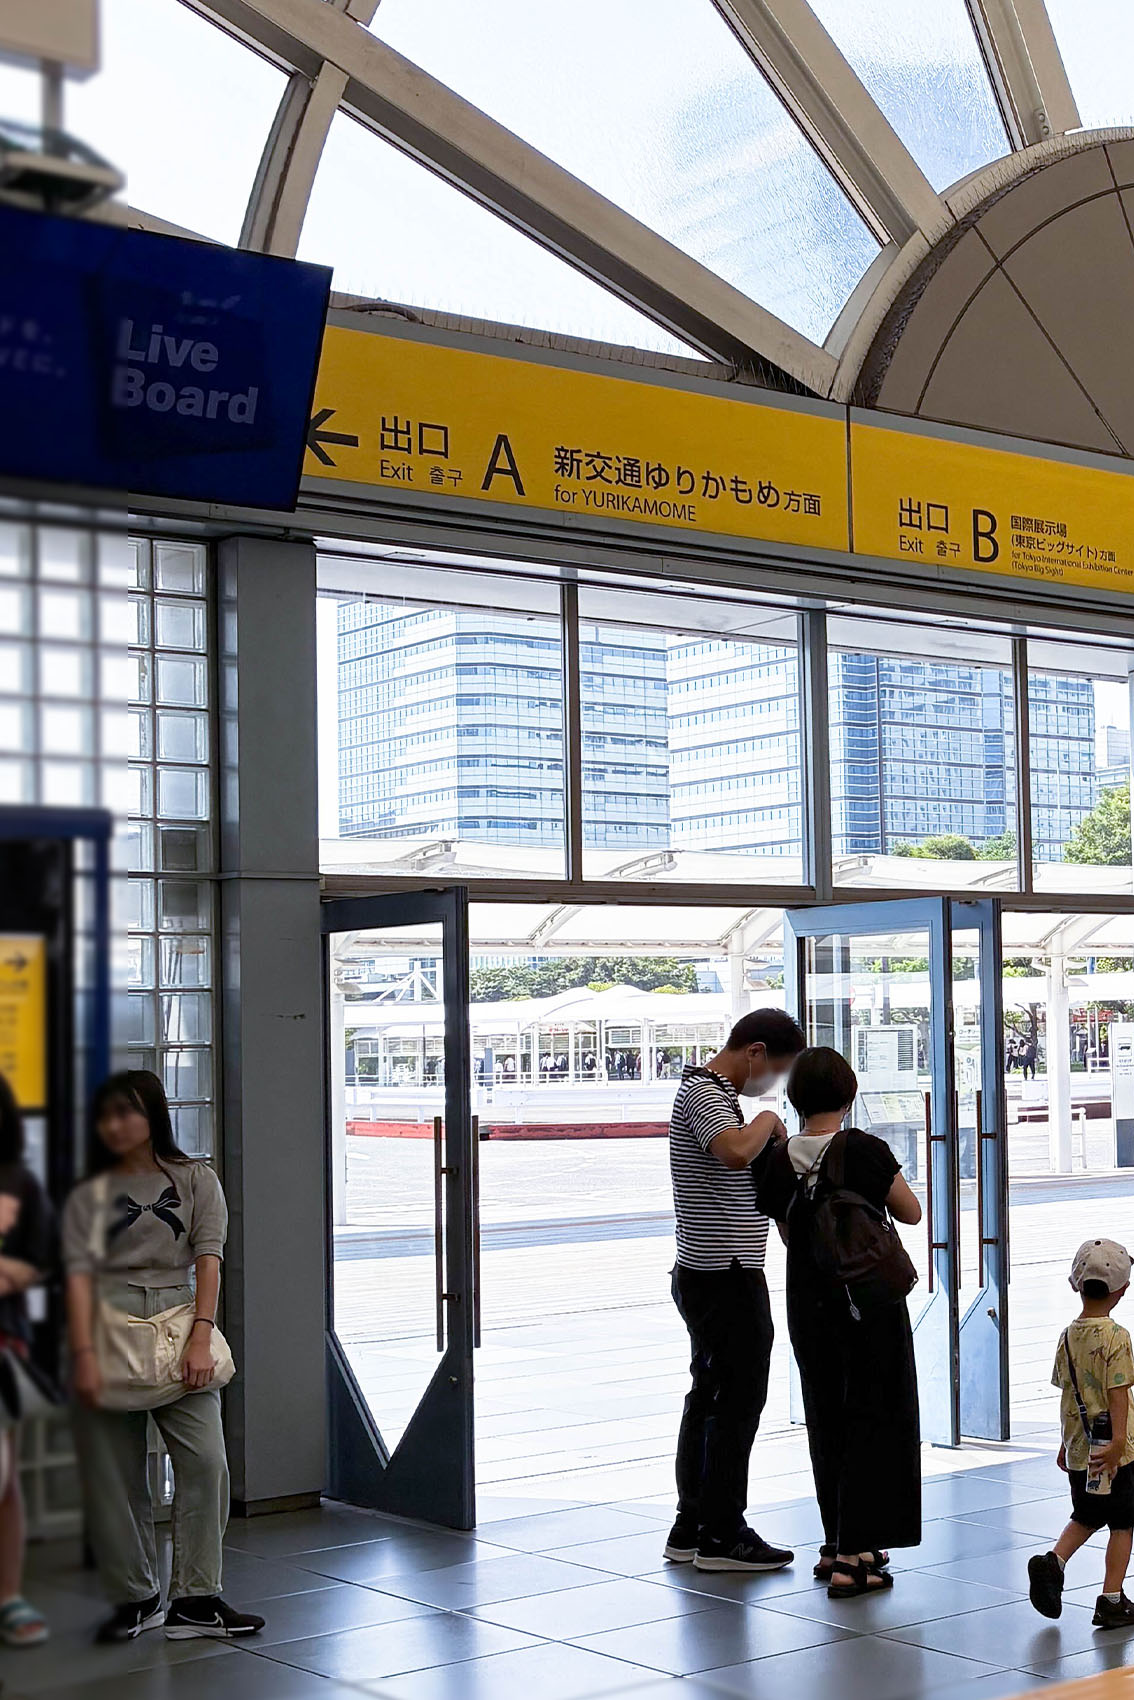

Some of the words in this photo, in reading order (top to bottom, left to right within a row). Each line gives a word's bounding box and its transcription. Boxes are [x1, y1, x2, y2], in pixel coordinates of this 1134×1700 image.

[117, 320, 218, 372] Live
[111, 366, 258, 424] Board
[380, 416, 449, 459] 出口
[380, 460, 413, 482] Exit
[429, 466, 463, 487] 출구
[481, 434, 526, 496] A
[554, 445, 822, 516] 新交通ゆりかもめ方面
[554, 484, 578, 505] for
[581, 489, 697, 522] YURIKAMOME
[899, 497, 949, 534] 出口
[899, 535, 923, 554] Exit
[973, 508, 1000, 564] B
[1010, 515, 1067, 538] 国際展示場
[936, 540, 961, 558] 출구
[1011, 550, 1021, 559] for
[1022, 551, 1041, 563] Tokyo
[1042, 554, 1081, 569] International
[1082, 561, 1113, 573] Exhibition
[1113, 566, 1134, 577] Center
